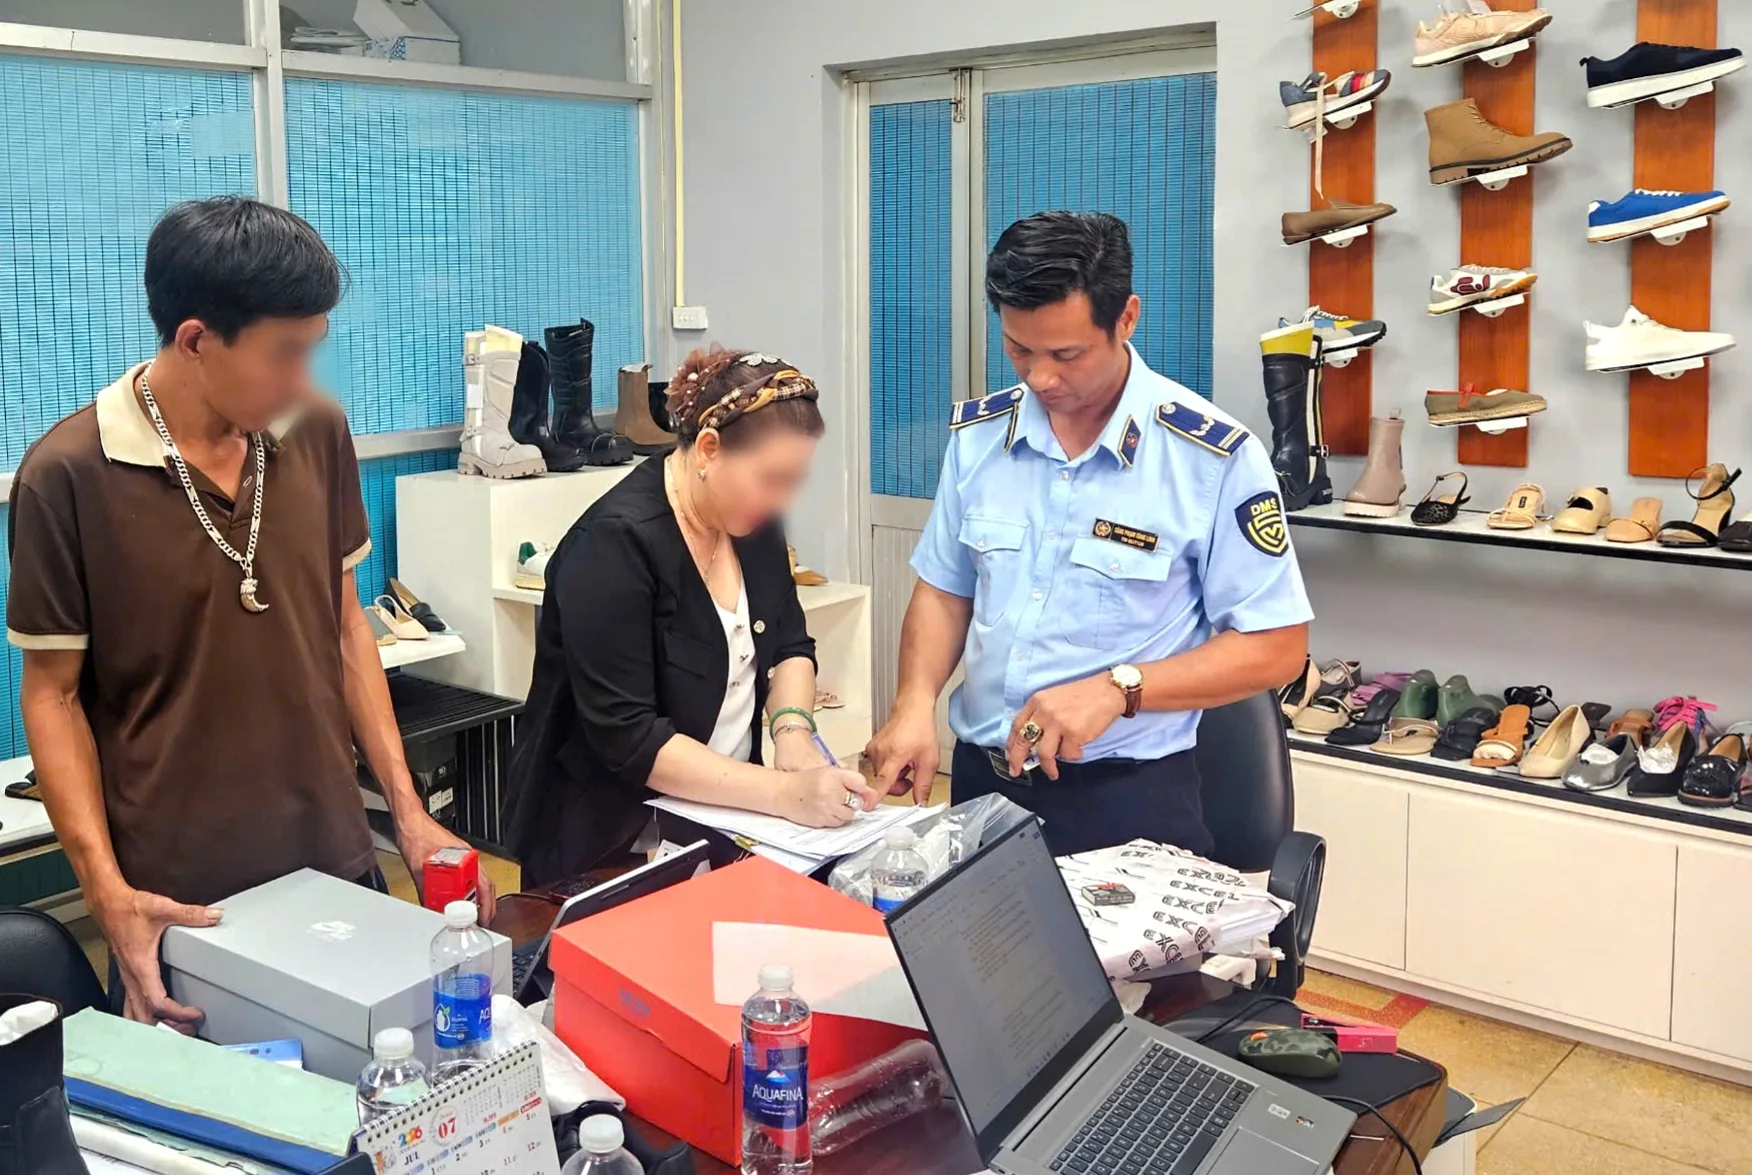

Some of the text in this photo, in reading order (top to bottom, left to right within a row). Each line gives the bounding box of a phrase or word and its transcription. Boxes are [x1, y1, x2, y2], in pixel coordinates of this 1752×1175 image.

[1250, 497, 1278, 516] DMS
[752, 1083, 804, 1102] AQUAFINA
[438, 1116, 456, 1139] 07
